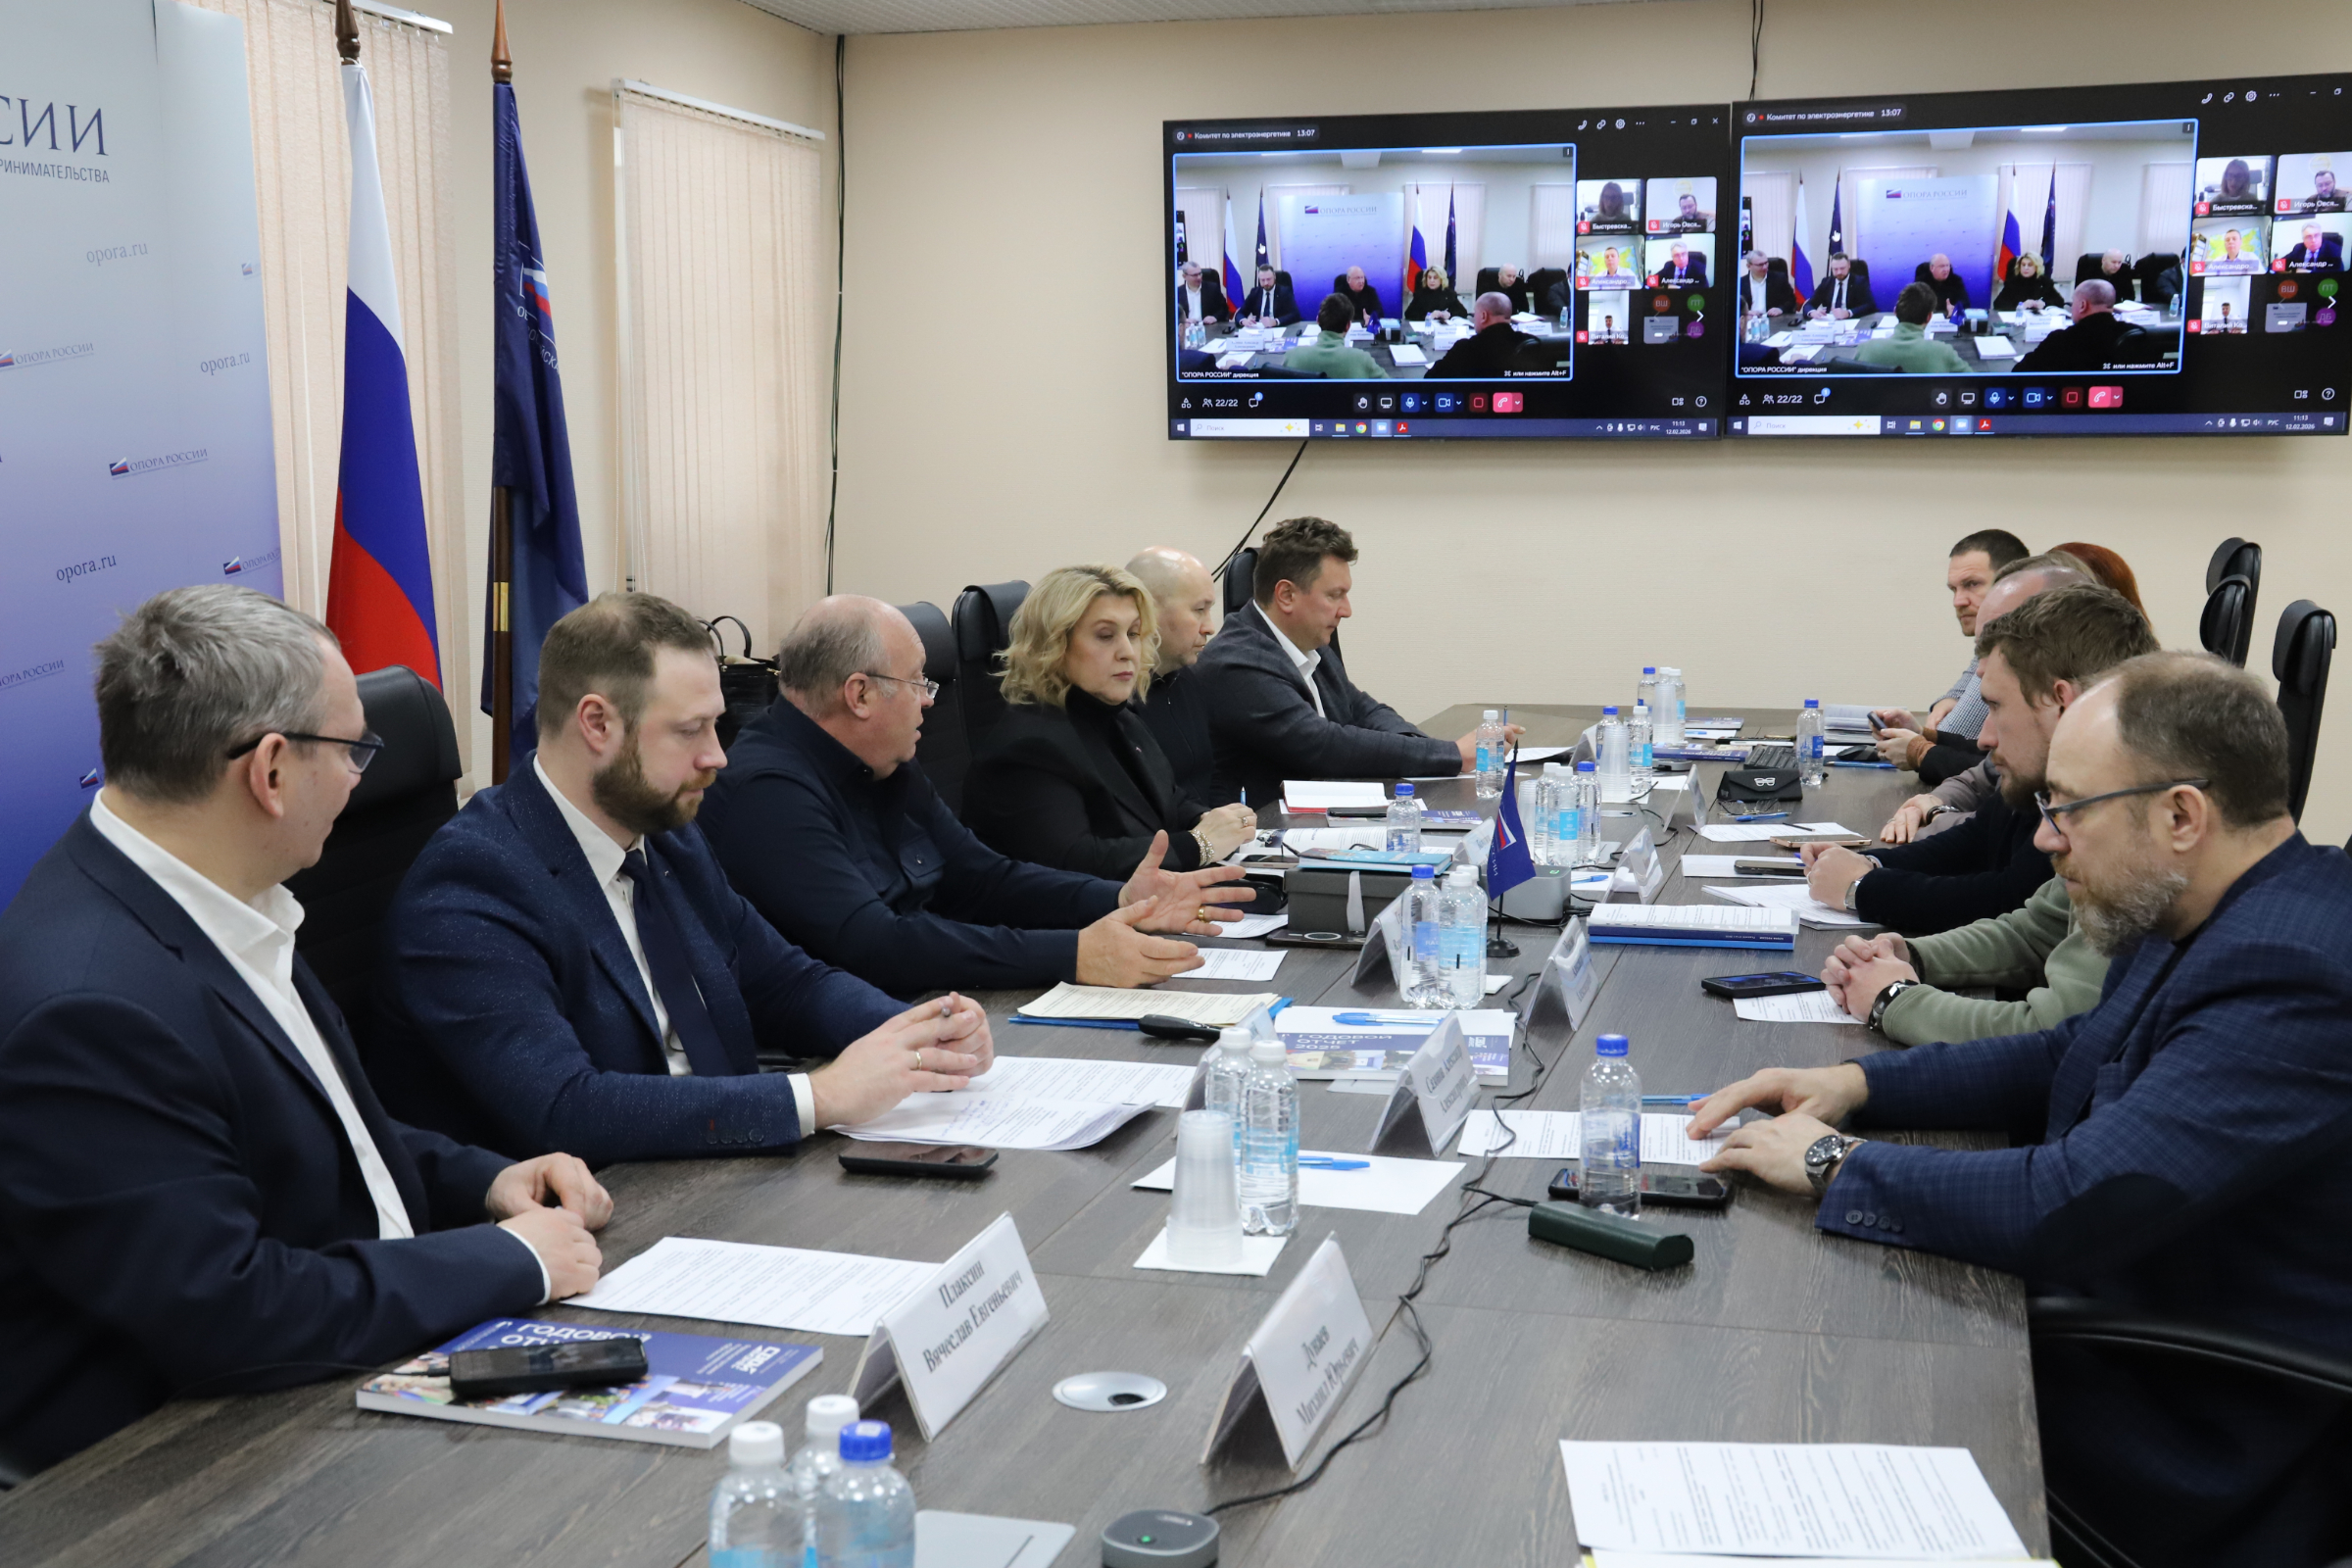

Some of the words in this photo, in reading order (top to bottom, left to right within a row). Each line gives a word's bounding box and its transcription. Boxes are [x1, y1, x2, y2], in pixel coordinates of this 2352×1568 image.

[1766, 112, 1796, 121] Комитет
[1807, 110, 1875, 121] электроэнергетике
[1881, 108, 1902, 118] 13:07
[1194, 130, 1221, 140] Комитет
[1231, 130, 1292, 140] электроэнергетике
[1297, 128, 1315, 137] 13:07
[2293, 200, 2316, 209] Игорь
[86, 243, 149, 267] opora.ru
[2280, 284, 2295, 293] ВШ
[2319, 313, 2332, 321] ДБ
[16, 349, 51, 365] ОПОРА
[52, 343, 94, 359] РОССИИ
[200, 352, 251, 375] opora.ru
[1214, 398, 1239, 408] 22/22
[1777, 394, 1803, 405] 22/22
[129, 456, 165, 471] ОПОРА
[165, 448, 208, 465] РОССИИ
[56, 555, 117, 583] opora.ru
[23, 660, 65, 679] РОССИИ
[938, 1259, 986, 1309] Плаксин
[922, 1318, 974, 1374] Вячеслав
[968, 1269, 1024, 1329] Евгеньевич
